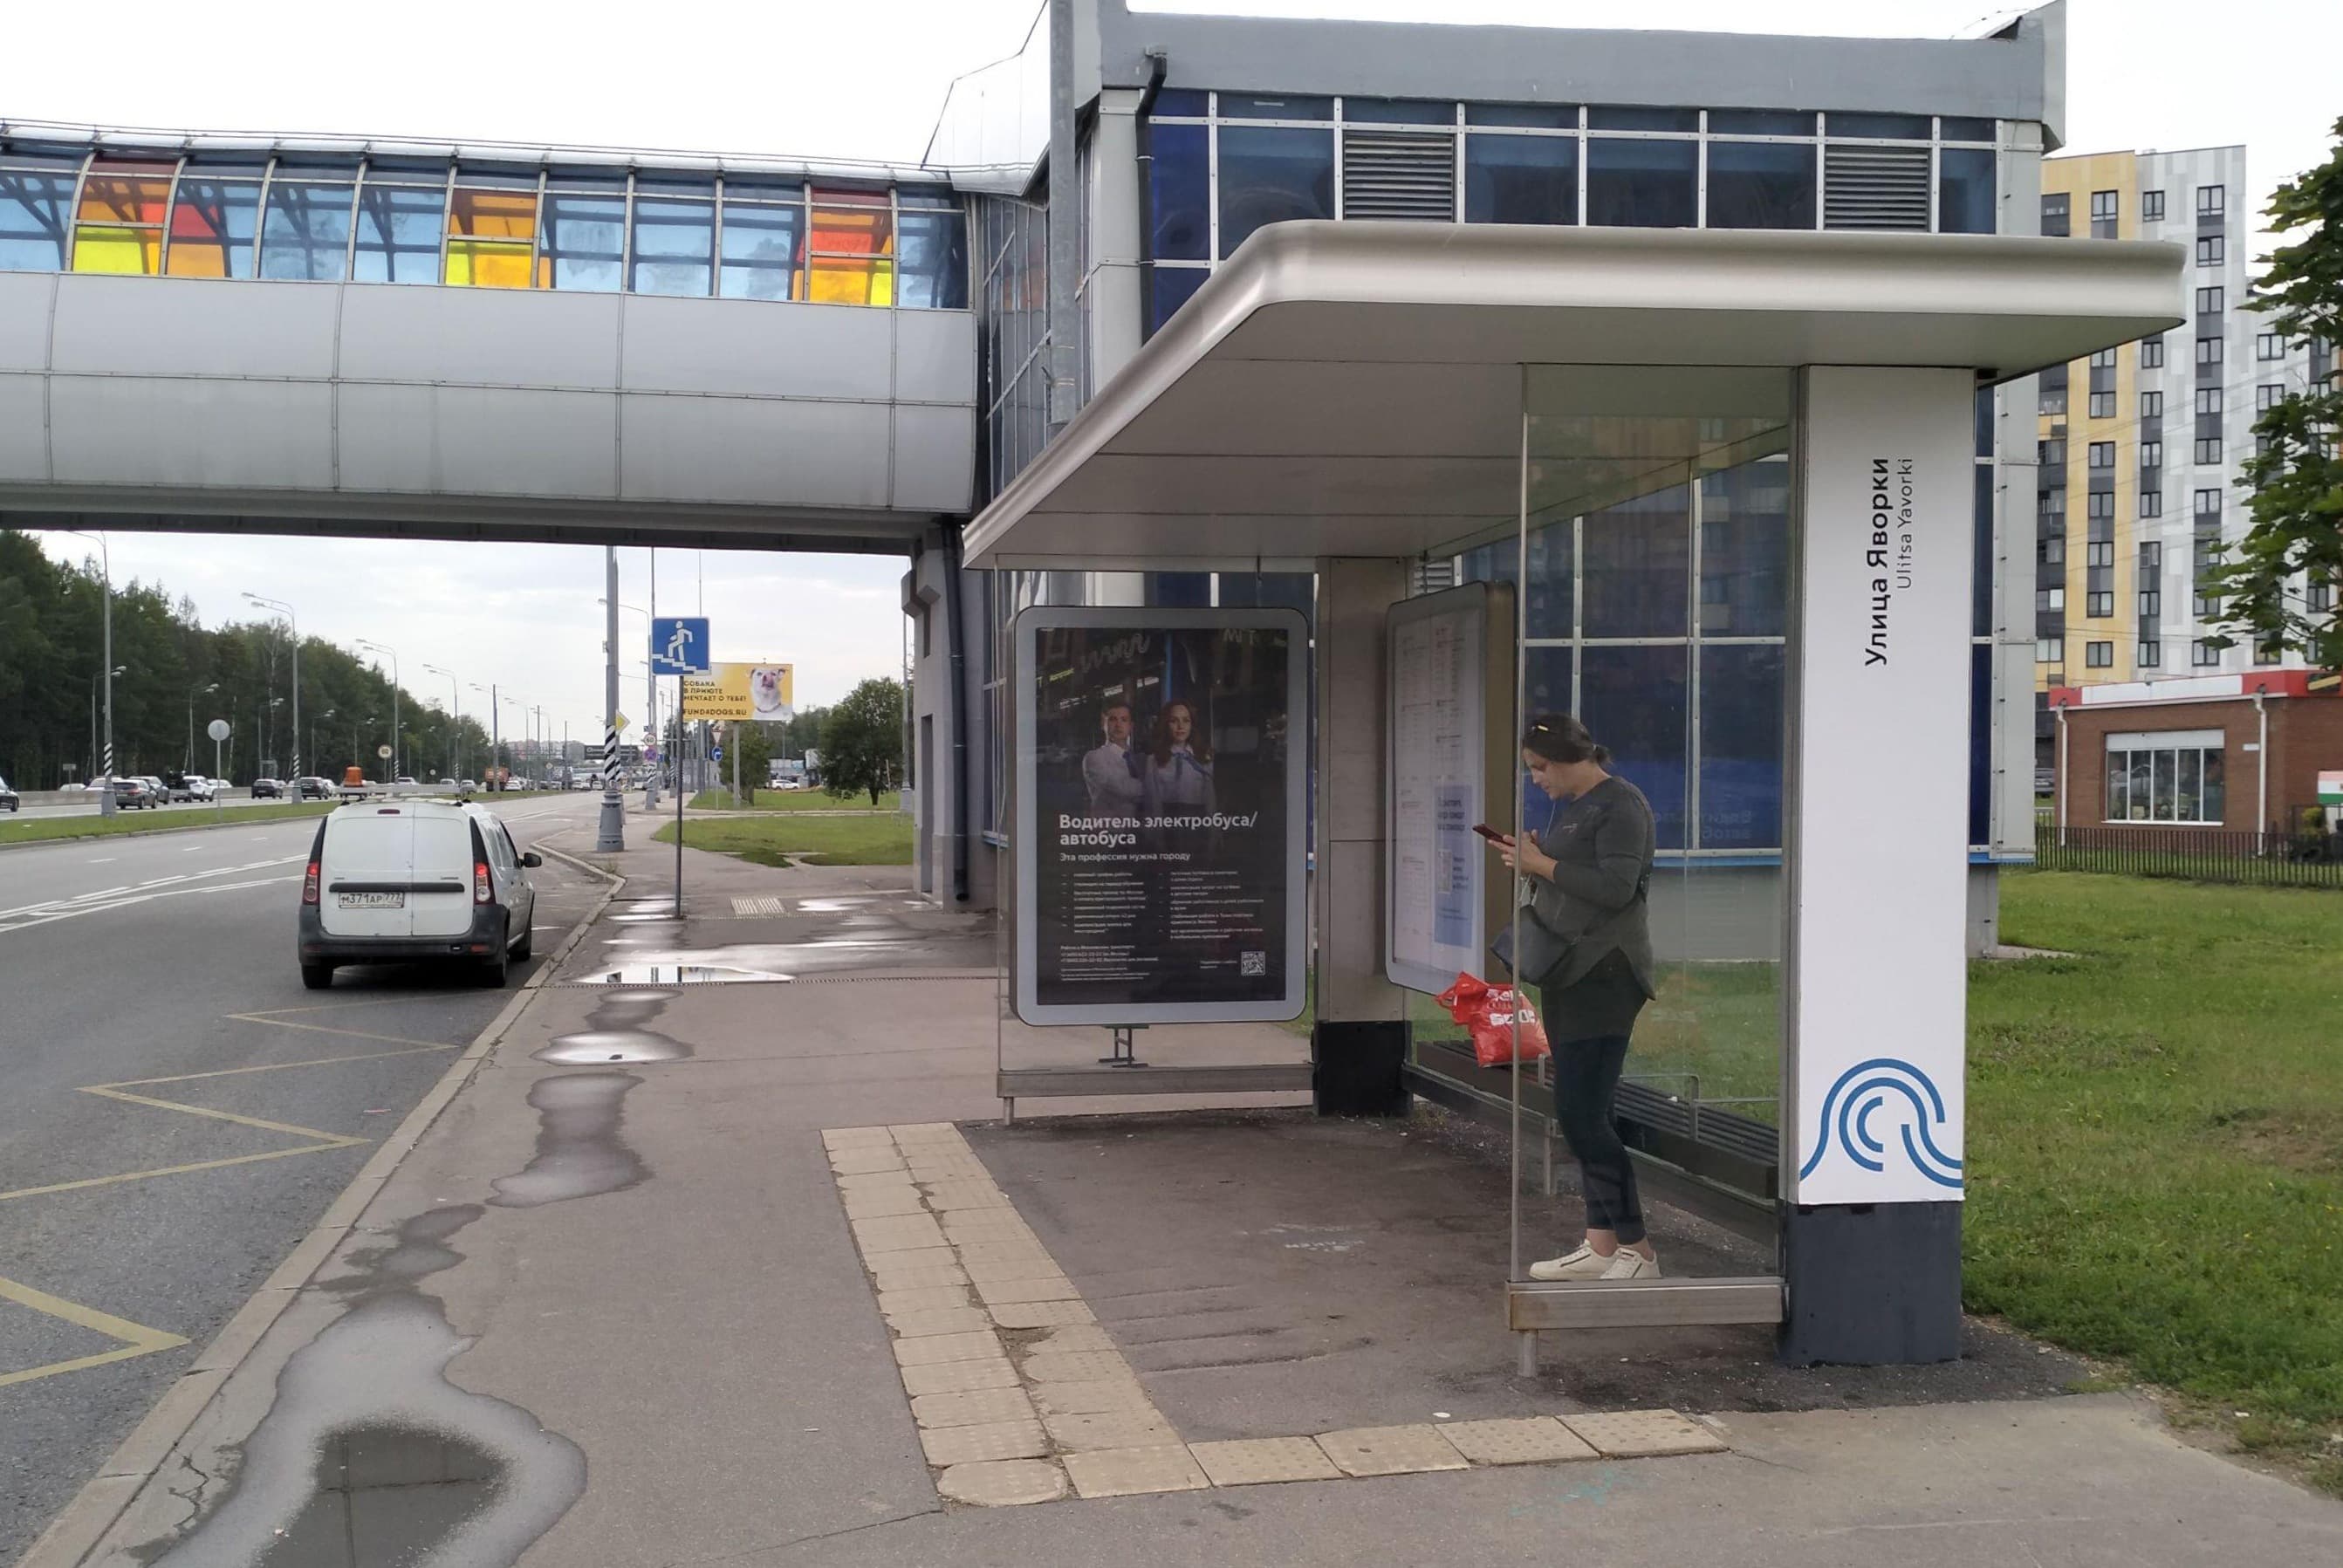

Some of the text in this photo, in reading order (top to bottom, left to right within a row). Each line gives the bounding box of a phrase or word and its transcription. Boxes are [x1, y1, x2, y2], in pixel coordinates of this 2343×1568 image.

[1896, 458, 1913, 589] Ulitsa Yavorki
[1865, 458, 1894, 666] Улица Яворки
[1058, 811, 1258, 831] Водитель электробуса/
[1059, 831, 1136, 848] автобуса
[1059, 852, 1191, 862] Эта профессия нужна городу
